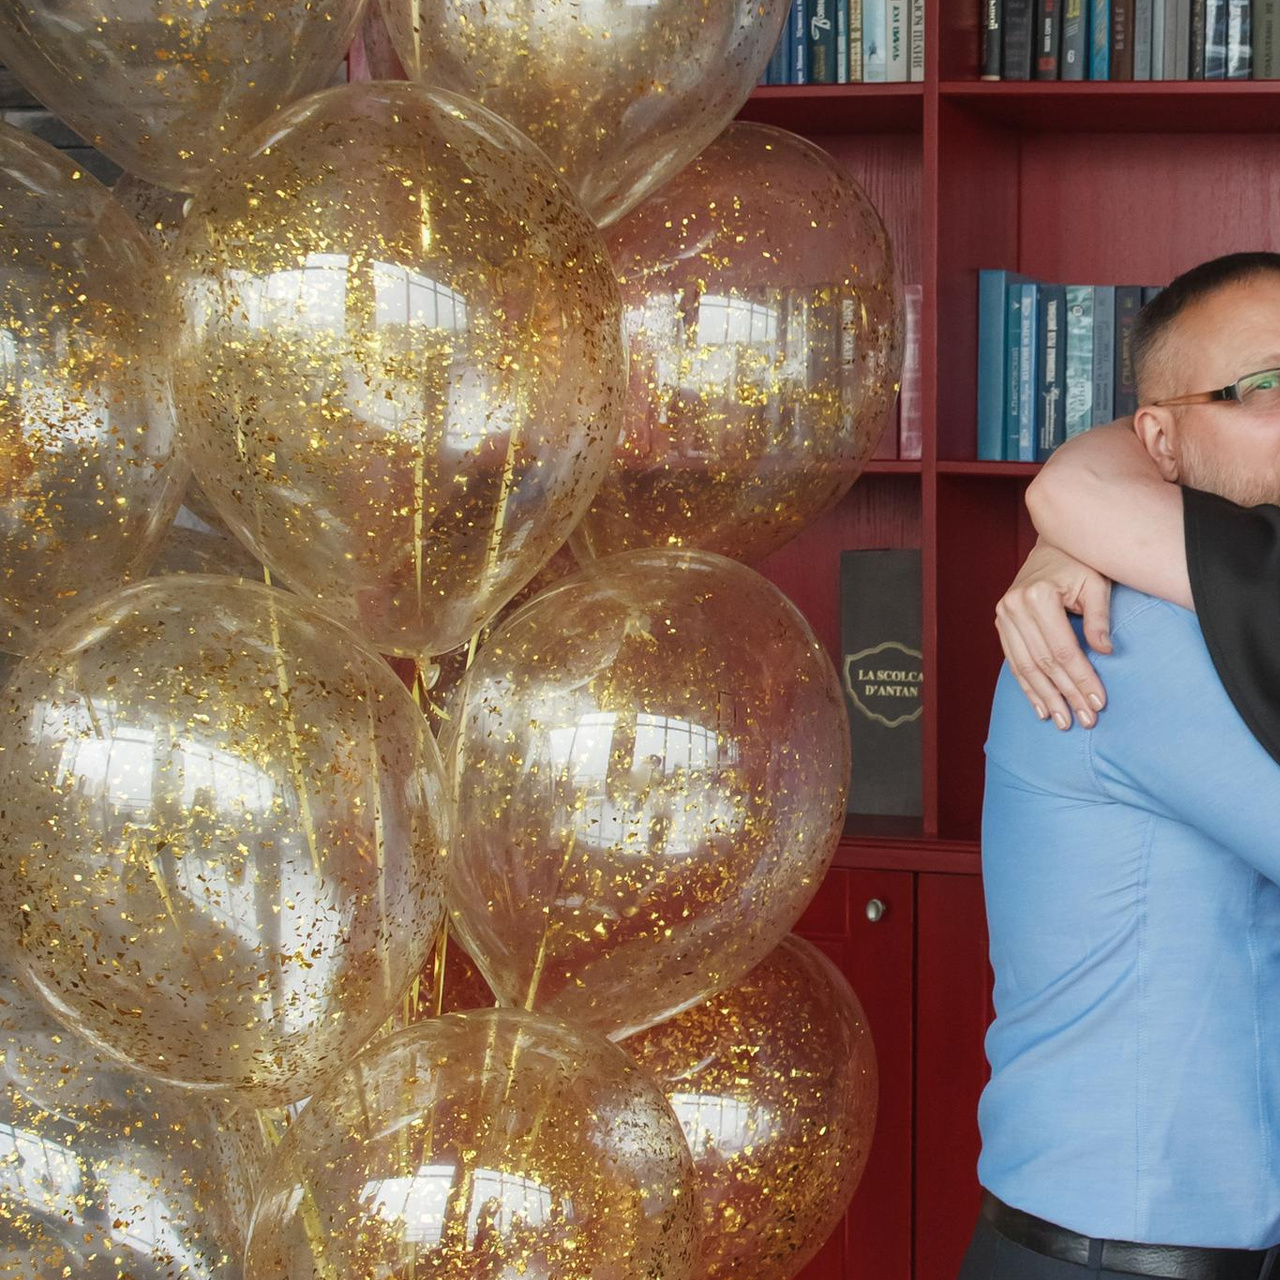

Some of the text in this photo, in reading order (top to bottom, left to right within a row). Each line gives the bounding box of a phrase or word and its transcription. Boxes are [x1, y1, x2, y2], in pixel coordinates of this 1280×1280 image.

[1115, 6, 1124, 50] БЕРЕГ
[913, 30, 923, 68] ЯНУШ
[1067, 50, 1075, 63] 6
[858, 669, 874, 681] LA
